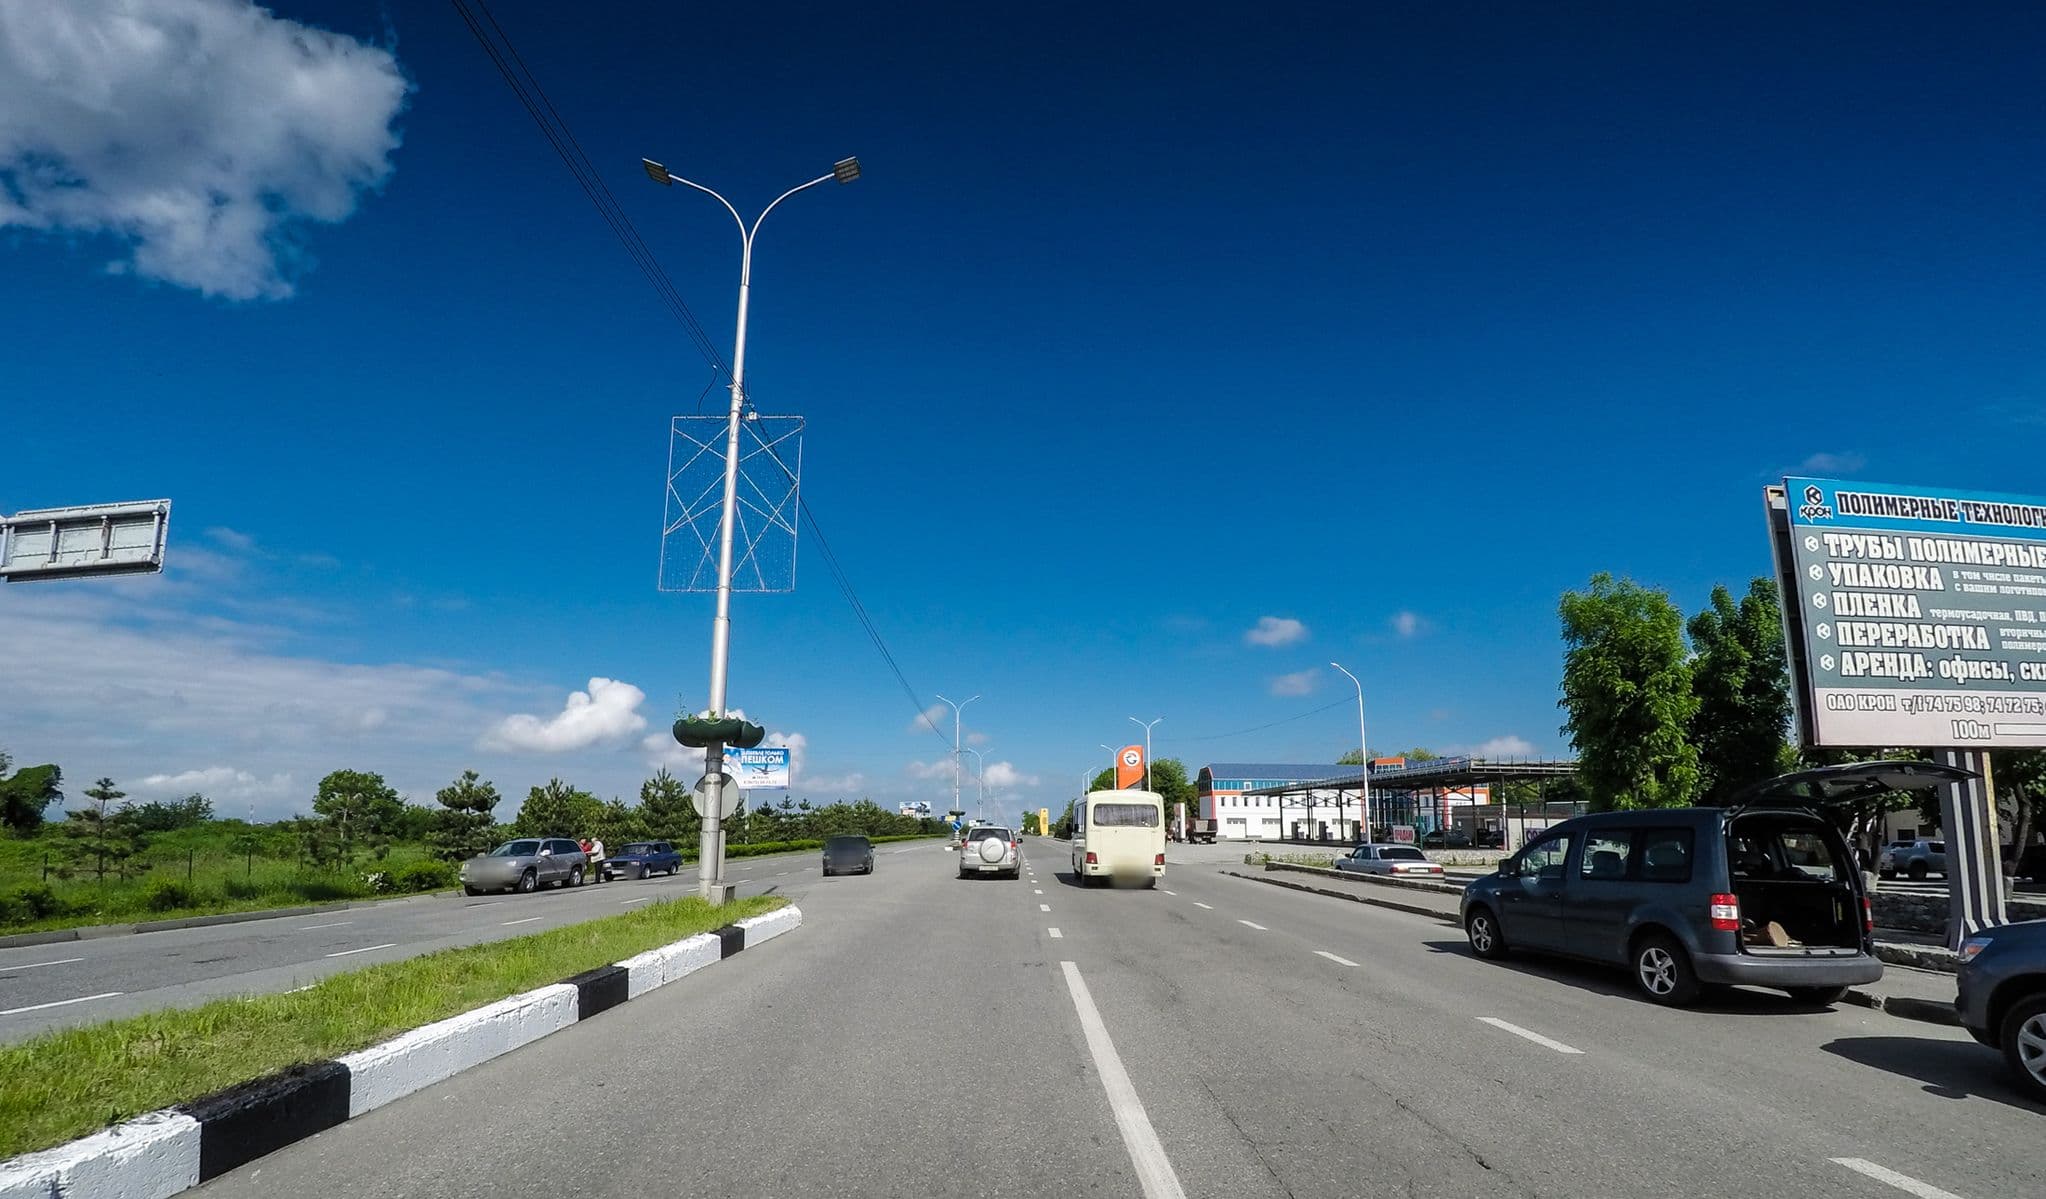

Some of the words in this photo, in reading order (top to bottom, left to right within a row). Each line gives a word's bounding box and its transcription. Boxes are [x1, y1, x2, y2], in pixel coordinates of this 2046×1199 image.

[1836, 492, 1958, 520] ПОЛИМЕРНЫЕ
[1823, 533, 1903, 560] ТРУБЫ
[1908, 538, 2046, 568] ПОЛИМЕРНЫЕ
[1827, 562, 1945, 591] УПАКОВКА
[1961, 571, 1981, 580] том
[1982, 572, 2011, 582] числе
[1963, 583, 1998, 593] вашим
[1831, 591, 1923, 619] ПЛЕНКА
[1835, 622, 1992, 650] ПЕРЕРАБОТКА
[1840, 651, 1934, 681] АРЕНДА:
[1938, 654, 2016, 684] офисы,
[1826, 693, 1854, 711] ОАО
[1857, 694, 1897, 712] КРОН
[1926, 695, 1944, 712] 74
[1945, 696, 1962, 713] 75
[1987, 696, 2004, 714] 74
[2006, 696, 2023, 714] 72
[1951, 720, 1992, 739] 100м
[741, 755, 784, 764] ПЕШКОМ
